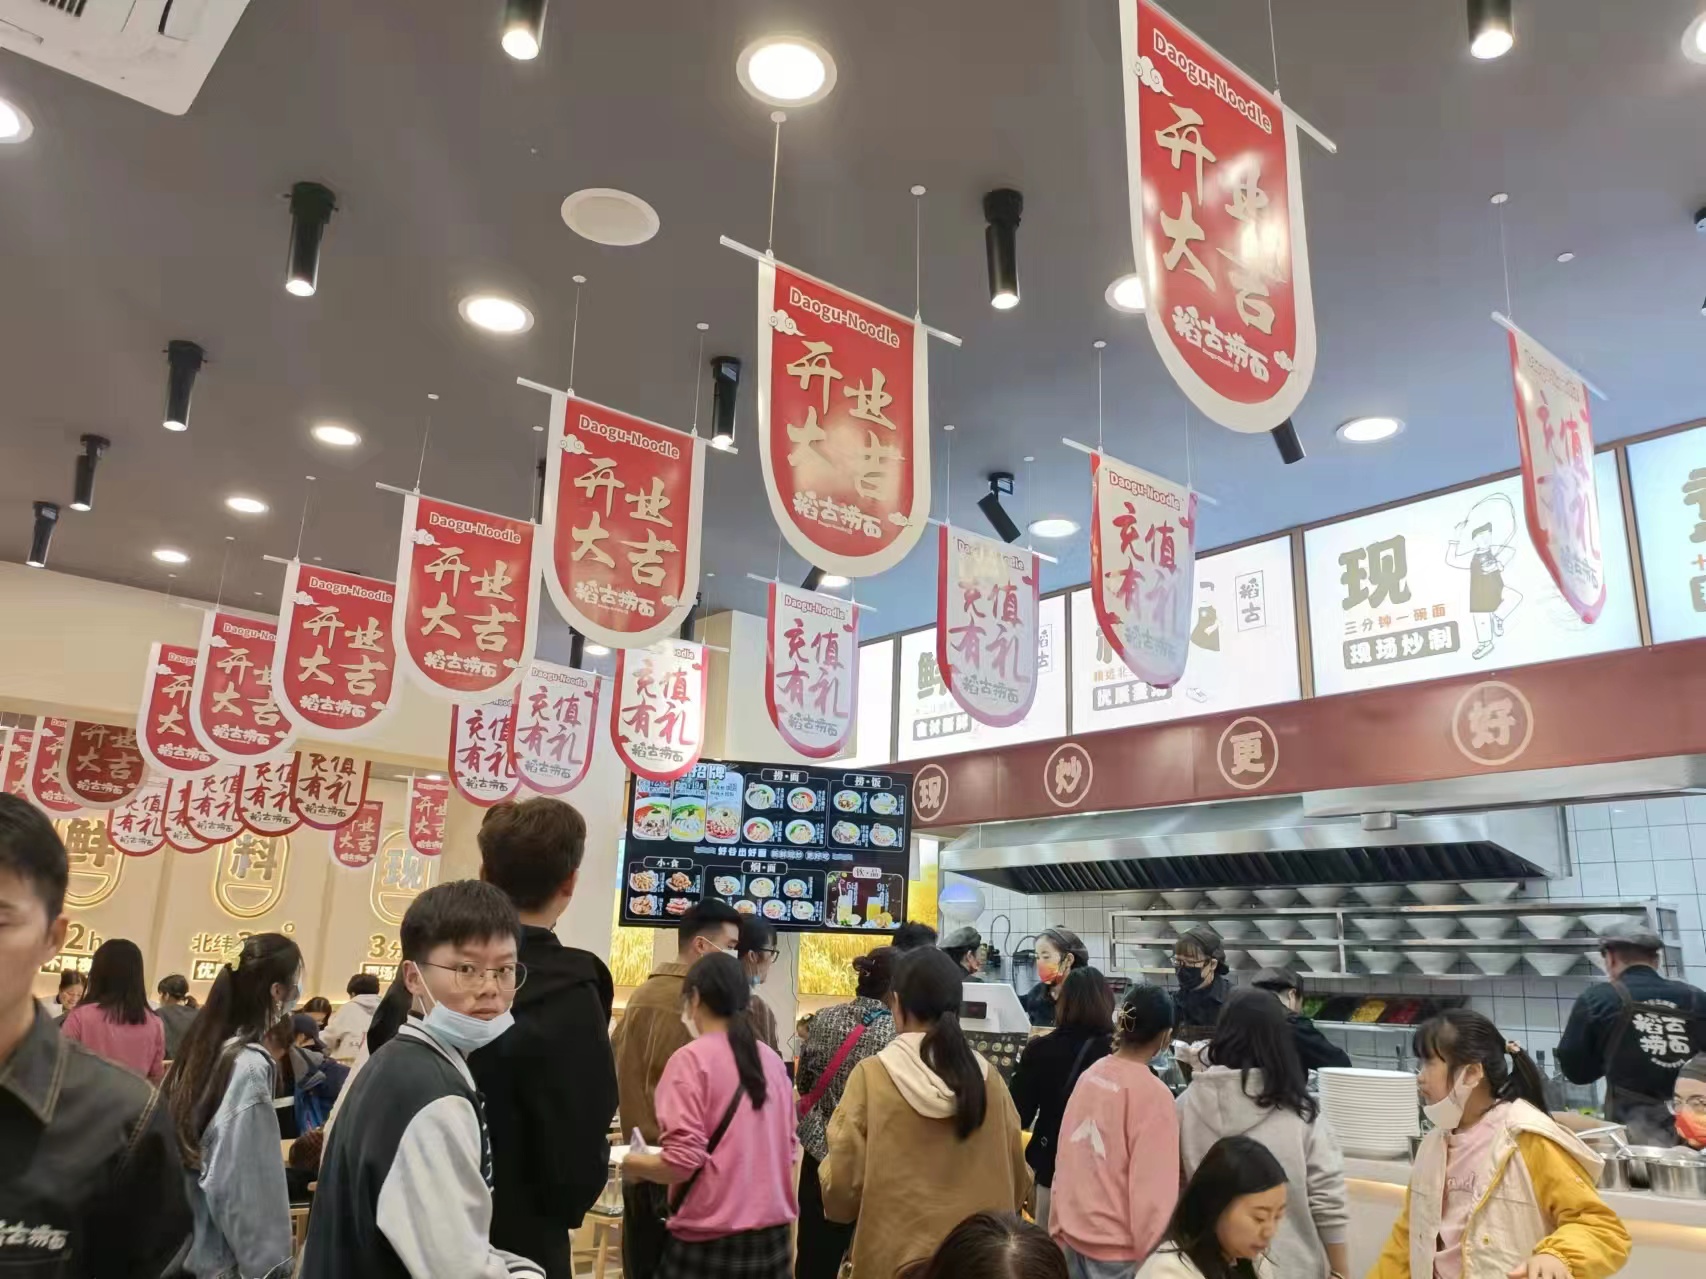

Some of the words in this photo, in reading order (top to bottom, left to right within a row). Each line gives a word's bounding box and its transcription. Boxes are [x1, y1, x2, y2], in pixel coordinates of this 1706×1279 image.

[1153, 28, 1272, 134] Daogu-Noodle
[789, 286, 900, 349] Daogu-Noodle
[1172, 305, 1270, 383] 稻古捞面
[786, 341, 897, 430] 开业
[579, 414, 680, 460] Daogu-Noodle
[574, 457, 673, 527] 开业
[1109, 471, 1181, 511] Daogu-Noodle
[429, 512, 521, 544] Daogu-Noodle
[792, 490, 882, 539] 稻古捞面
[571, 511, 680, 587] 大吉
[1113, 501, 1176, 574] 充值
[309, 576, 393, 604] Daogu-Noodle
[424, 547, 515, 601] 开业
[1338, 534, 1412, 611] 现
[574, 579, 656, 618] 稻古捞面
[785, 594, 845, 620] Daogu-Noodle
[302, 606, 385, 653] 开业
[421, 592, 520, 652] 大吉
[1345, 603, 1446, 636] 三分钟一碗面
[424, 649, 497, 678] 稻古捞面
[784, 618, 845, 669] 充值
[949, 616, 1031, 684] 有礼
[298, 644, 389, 697] 大吉
[531, 668, 587, 688] Daogu-Noodle
[635, 659, 691, 703] 充值
[776, 662, 849, 718] 有礼
[961, 674, 1019, 704] 稻古捞面
[156, 704, 187, 737] 大
[211, 681, 281, 727] 大吉
[300, 693, 367, 718] 稻古捞面
[529, 685, 581, 727] 充值
[621, 701, 697, 745] 有礼
[788, 712, 838, 736] 稻古捞面
[212, 723, 271, 746] 稻古捞面
[466, 709, 510, 741] 充值
[518, 722, 583, 764] 有礼
[76, 747, 140, 780] 大吉
[458, 744, 517, 778] 有礼
[525, 760, 572, 779] 稻古捞面
[631, 743, 684, 762] 稻古捞面
[682, 764, 726, 780] 招牌
[1230, 730, 1265, 775] 更
[299, 775, 358, 806] 有礼
[466, 776, 508, 792] 稻古捞面
[919, 775, 941, 810] 现
[1055, 755, 1082, 795] 炒
[115, 811, 162, 837] 有礼
[229, 832, 278, 880] 料
